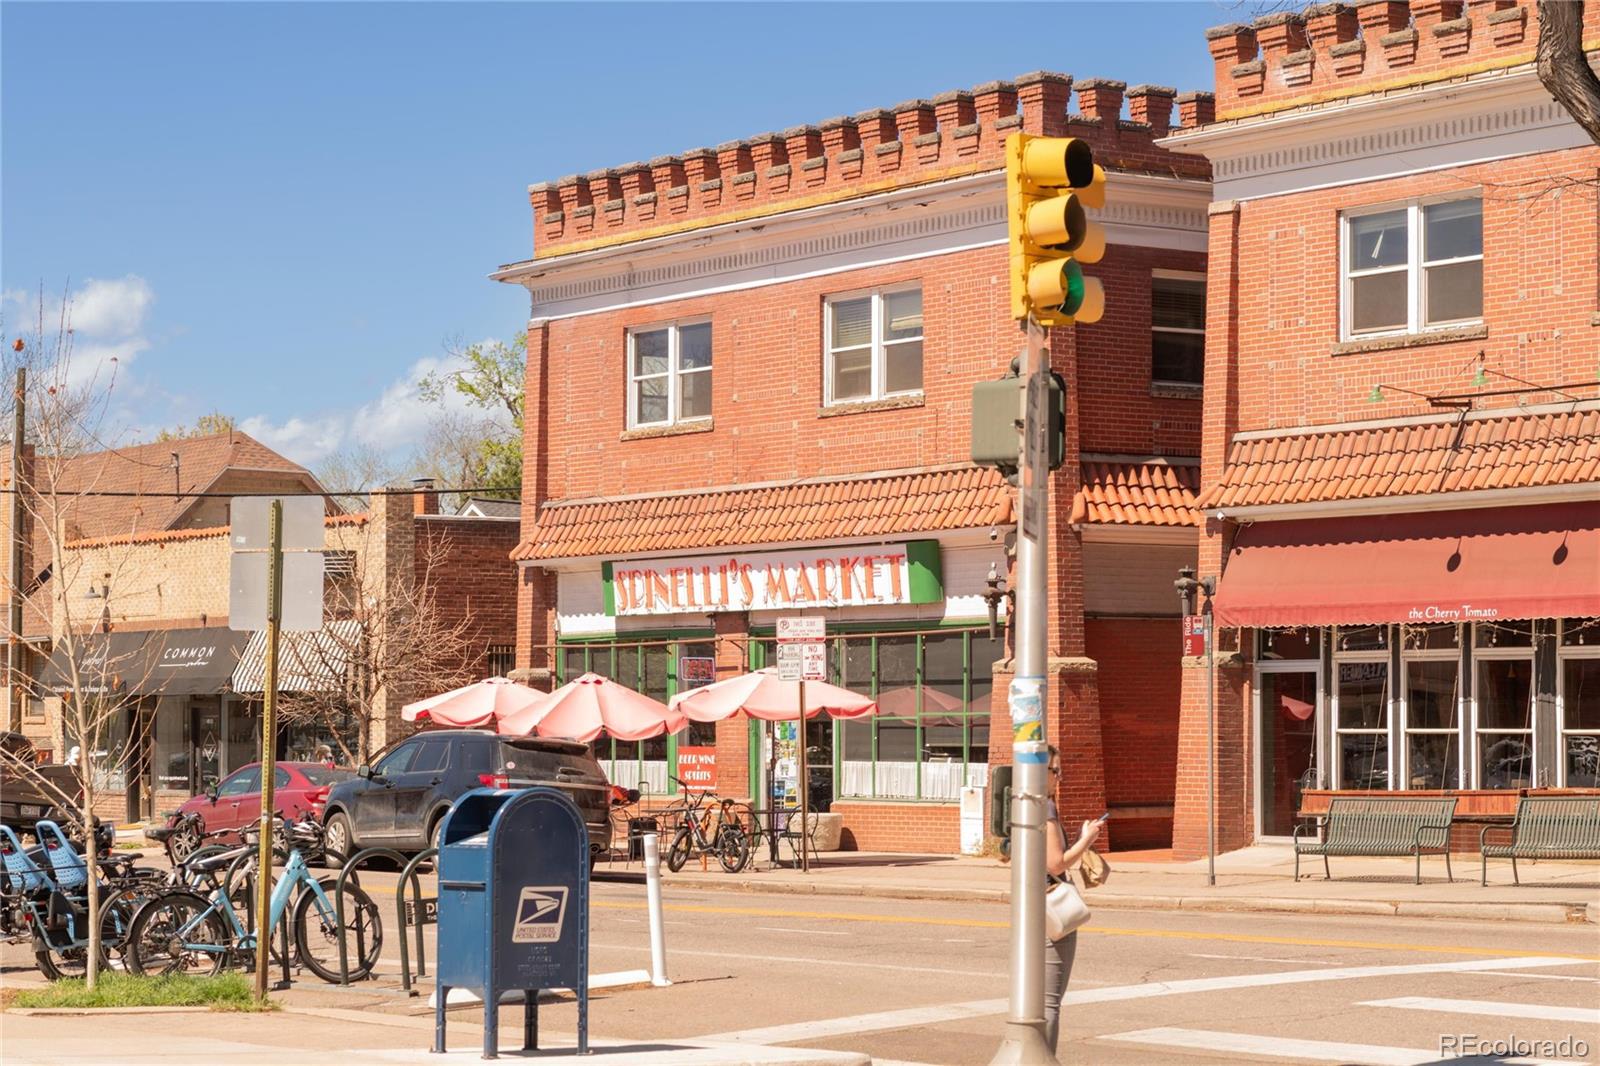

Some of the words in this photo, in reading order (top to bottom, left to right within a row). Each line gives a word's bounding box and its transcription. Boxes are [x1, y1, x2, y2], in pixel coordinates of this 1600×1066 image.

[614, 558, 754, 615] SPINELLI'S
[763, 553, 906, 606] MARKET
[1408, 607, 1423, 619] the
[1425, 606, 1460, 620] Cherry
[1462, 604, 1498, 617] Tomato
[164, 646, 216, 660] COMMON
[699, 754, 716, 765] WINE
